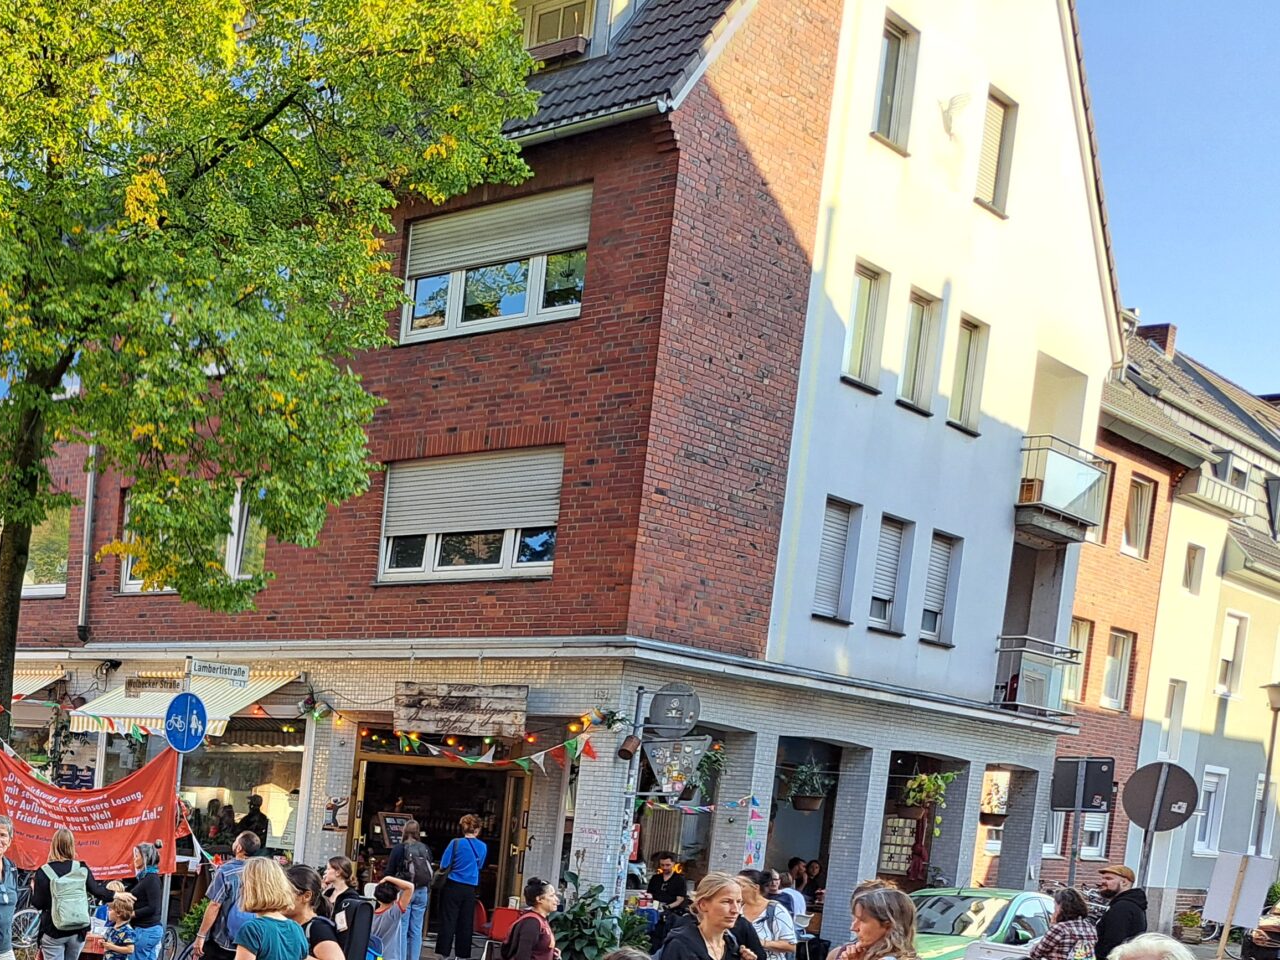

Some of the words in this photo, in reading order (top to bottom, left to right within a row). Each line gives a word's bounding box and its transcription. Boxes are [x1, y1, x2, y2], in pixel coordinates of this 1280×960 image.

[193, 661, 246, 677] Lambertistraße
[127, 678, 158, 689] Wolbecker
[160, 679, 180, 689] Straße
[3, 794, 18, 807] Der
[66, 815, 89, 823] neuen
[90, 810, 111, 821] Welt
[5, 785, 19, 796] mit
[69, 805, 79, 814] ist
[81, 802, 109, 812] unsere
[16, 810, 51, 828] Friedens
[68, 823, 81, 831] der
[83, 820, 114, 831] Freiheit
